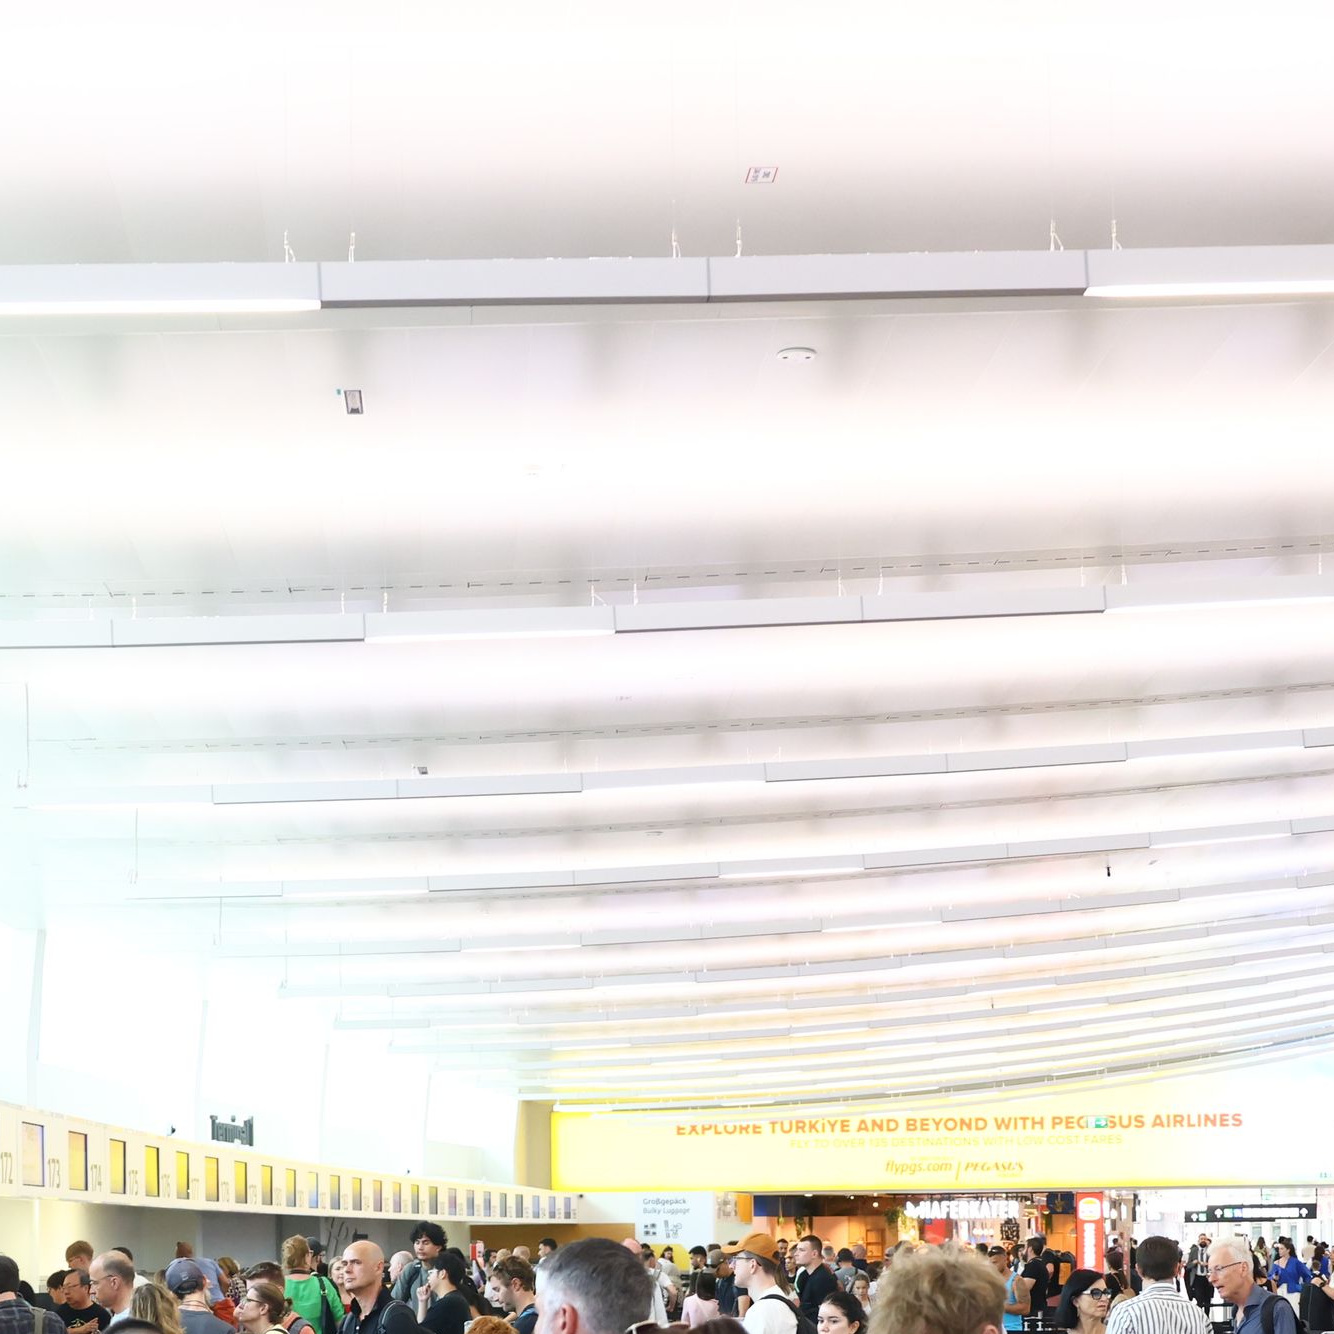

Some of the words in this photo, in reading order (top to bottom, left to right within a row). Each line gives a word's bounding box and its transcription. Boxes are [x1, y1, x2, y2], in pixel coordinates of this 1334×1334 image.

[675, 1123, 763, 1137] EXPLORE
[856, 1118, 900, 1133] AND
[906, 1117, 989, 1132] BEYOND
[994, 1116, 1045, 1131] WITH
[1151, 1113, 1244, 1128] AIRLINES
[789, 1139, 810, 1149] FLY
[813, 1138, 830, 1148] TO
[832, 1138, 866, 1148] OVER
[891, 1137, 980, 1148] DESTINATIONS
[982, 1136, 1015, 1146] WITH
[1017, 1135, 1044, 1146] LOW
[1046, 1134, 1081, 1145] COST
[1083, 1134, 1123, 1145] FARES
[0, 1151, 14, 1185] 172
[47, 1157, 61, 1189] 173
[885, 1159, 953, 1176] flypgs.com
[964, 1161, 1026, 1172] PEGASUS
[642, 1198, 687, 1206] Großgepäck
[642, 1207, 661, 1215] Bulky
[663, 1207, 691, 1215] Luggage
[919, 1200, 1020, 1219] HAFERKATER
